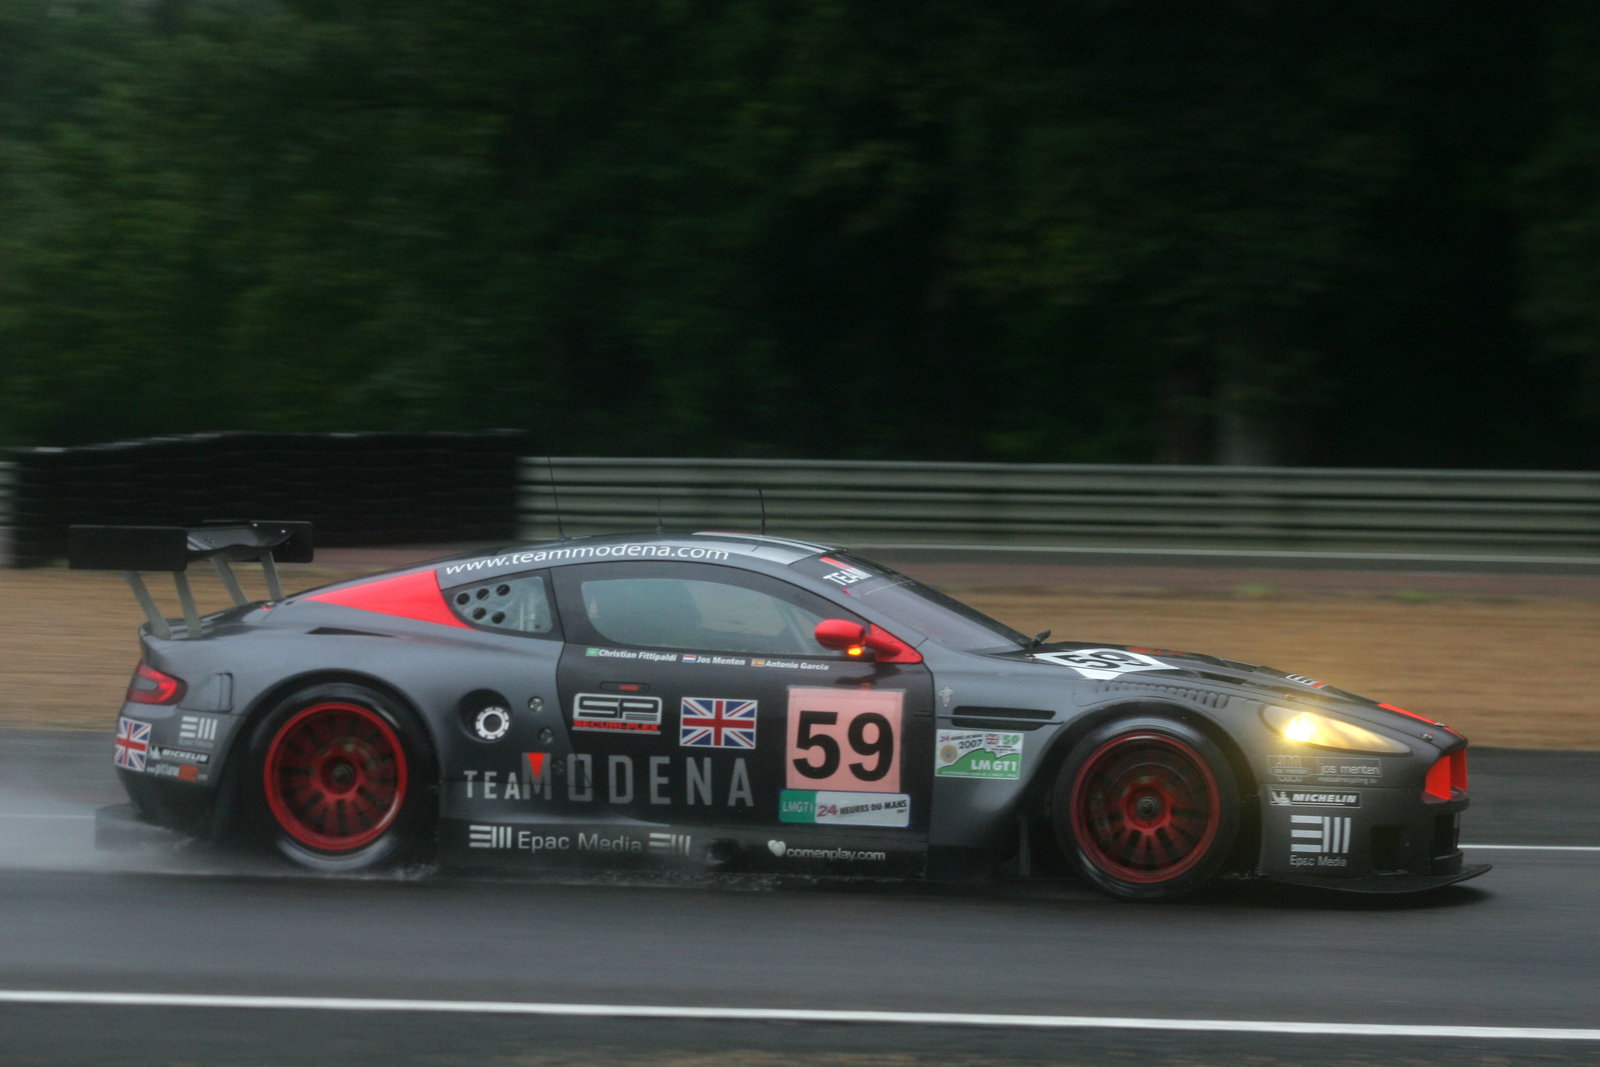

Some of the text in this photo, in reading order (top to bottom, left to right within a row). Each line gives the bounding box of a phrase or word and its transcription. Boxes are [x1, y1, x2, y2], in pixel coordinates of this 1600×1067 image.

[446, 543, 729, 574] www.teammodena.com
[599, 649, 677, 662] Christian Fittipaldi
[696, 656, 745, 666] Jos Menten
[1052, 651, 1153, 669] 59
[765, 660, 829, 671] Antonio Garcia
[793, 710, 894, 782] 59
[1341, 765, 1379, 775] menten
[1292, 793, 1357, 803] MICHELIN
[817, 800, 907, 817] 24 HEURES DU MANS
[518, 831, 570, 853] Epac
[578, 832, 642, 852] Media
[787, 848, 886, 861] comenplay.com
[1290, 855, 1347, 867] Epac Media
